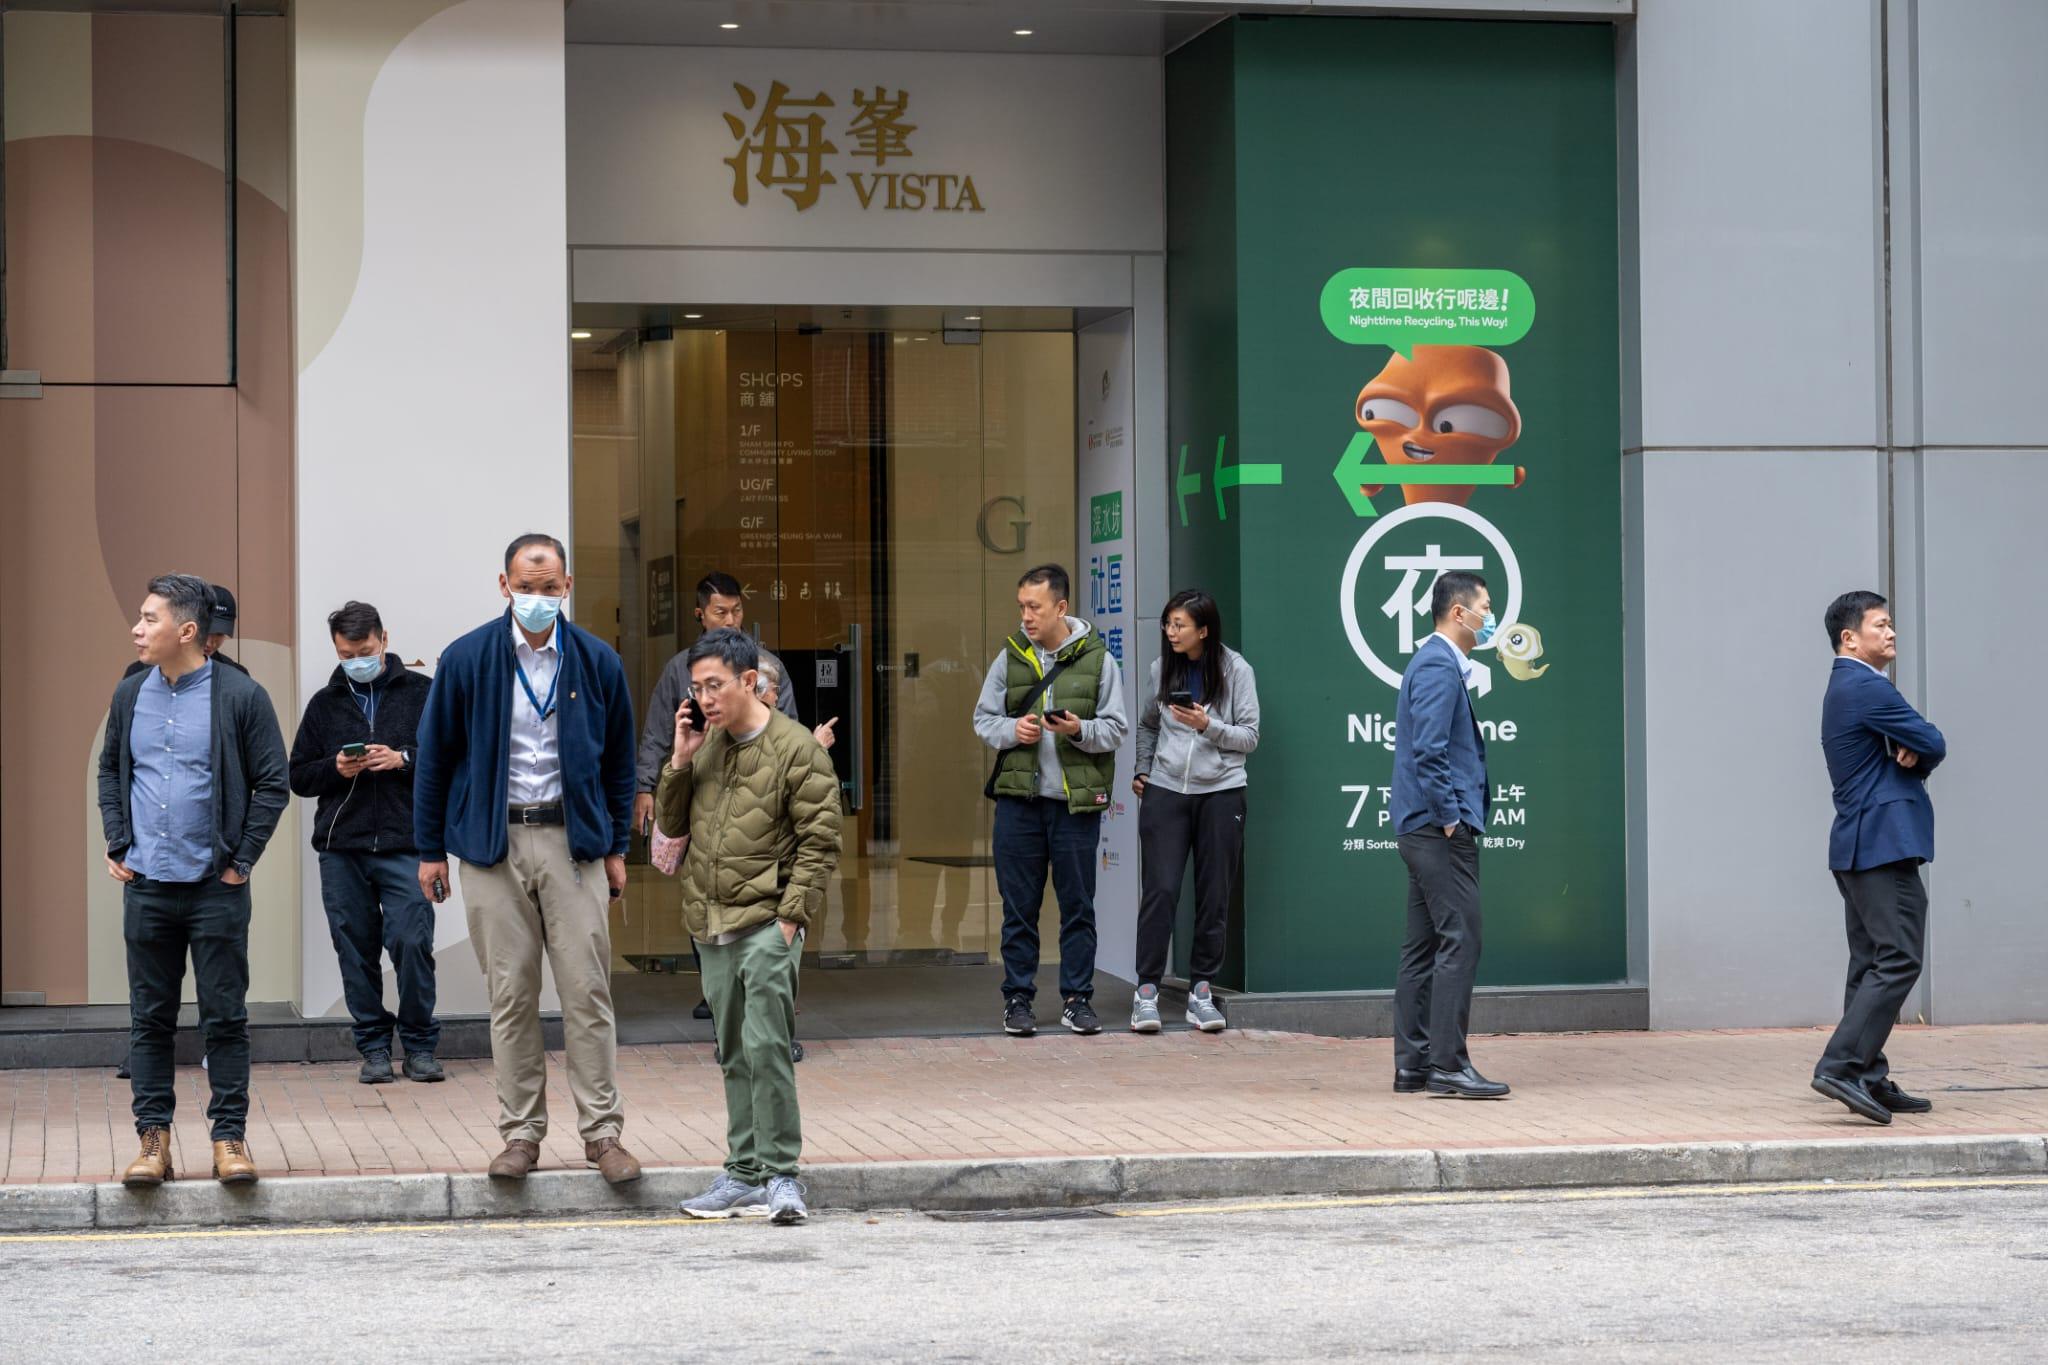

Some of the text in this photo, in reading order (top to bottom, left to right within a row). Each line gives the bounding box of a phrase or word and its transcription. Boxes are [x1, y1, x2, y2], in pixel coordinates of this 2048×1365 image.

[846, 172, 986, 213] VISTA
[1349, 287, 1509, 312] 夜間回收行呢邊!
[1349, 315, 1508, 329] Nighttime Recycling, This Way!
[739, 372, 803, 387] SHOPS
[740, 424, 761, 437] 1/F
[740, 478, 775, 491] UG/F
[740, 516, 764, 529] G/F
[1091, 554, 1122, 617] 社區
[1340, 783, 1526, 829] 7 下 上午
[1378, 808, 1525, 827] P AM
[1342, 839, 1364, 851] 分類
[1482, 837, 1504, 850] 乾爽
[1506, 837, 1525, 850] Dry
